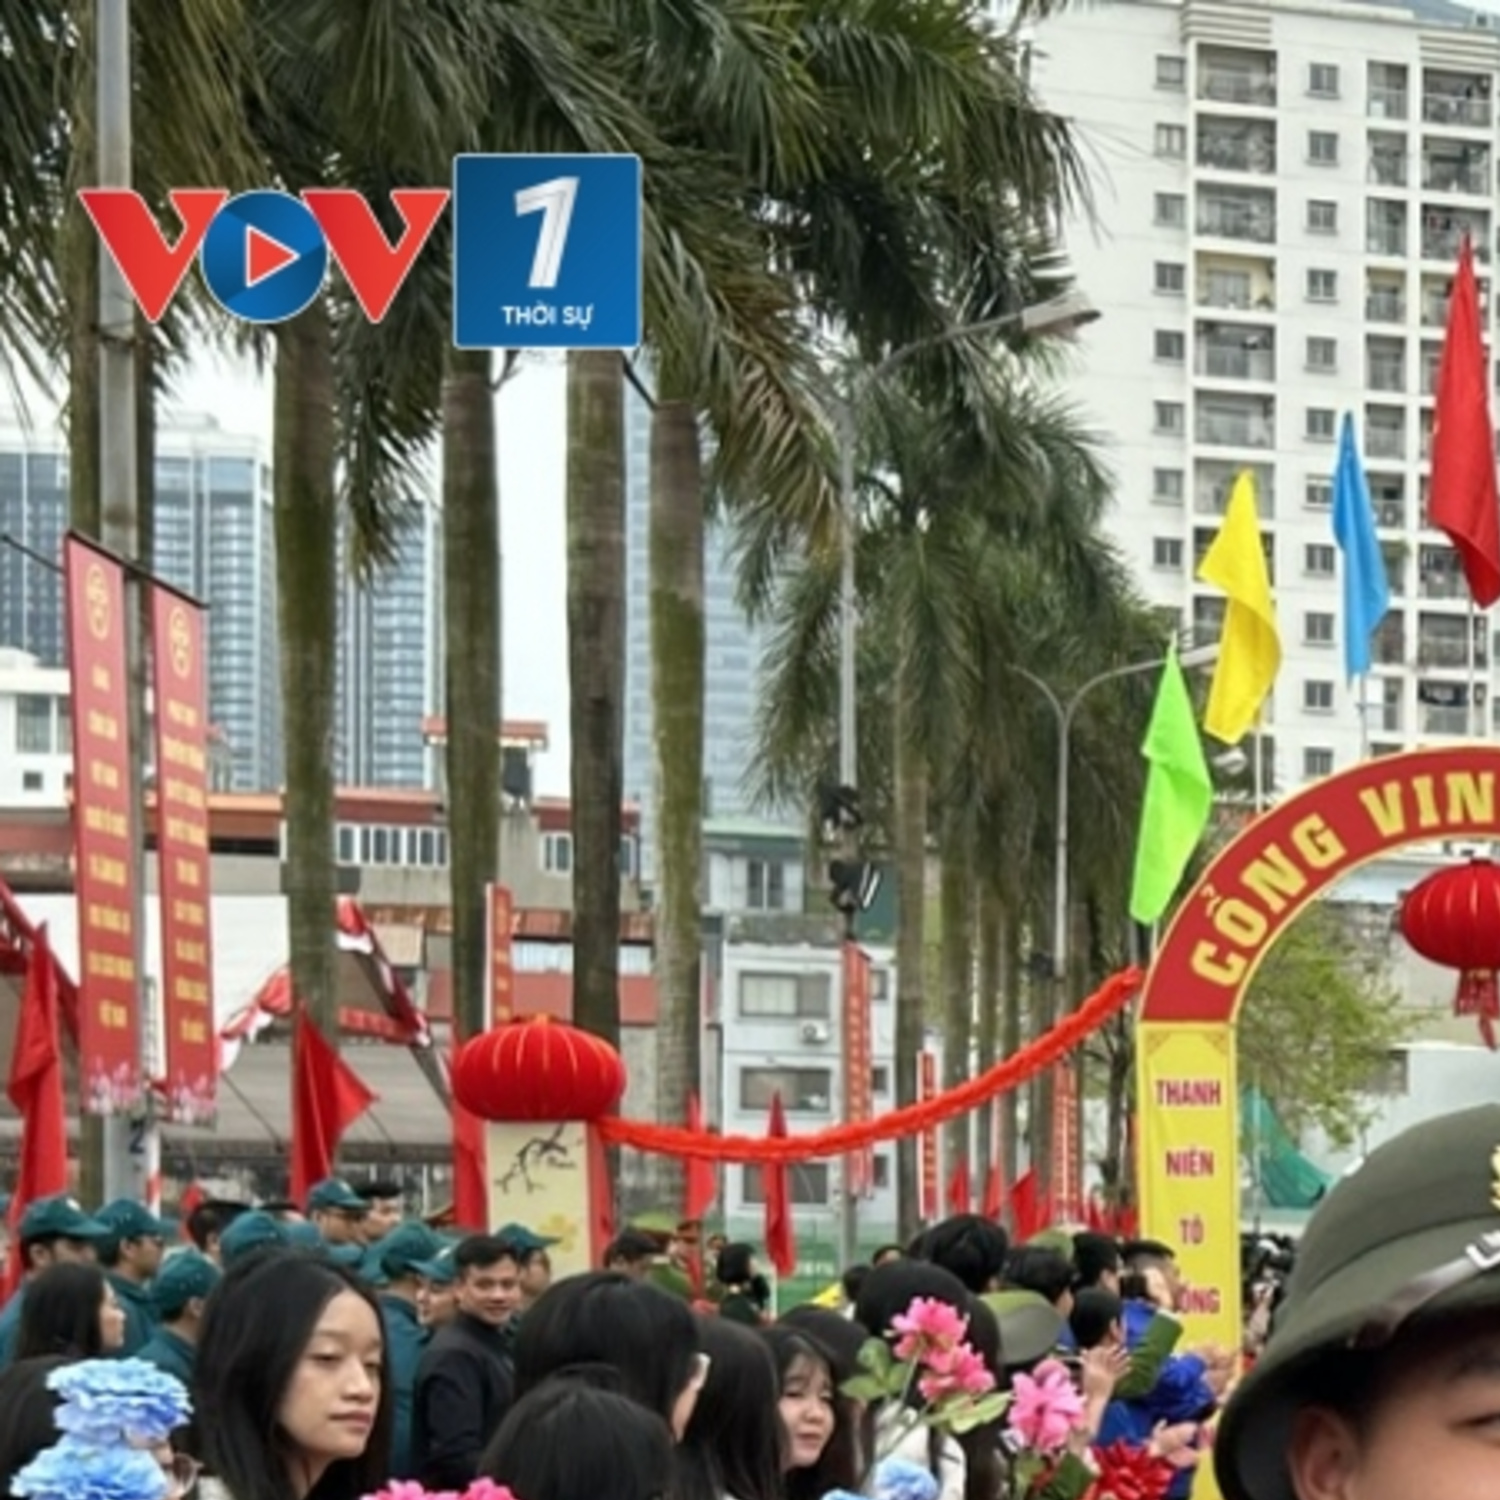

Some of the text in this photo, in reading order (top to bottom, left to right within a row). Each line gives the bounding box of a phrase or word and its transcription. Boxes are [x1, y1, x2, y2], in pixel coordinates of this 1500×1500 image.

[1190, 812, 1347, 986] CỔNG
[1156, 1080, 1222, 1106] THANH
[1166, 1145, 1215, 1177] NIÊN
